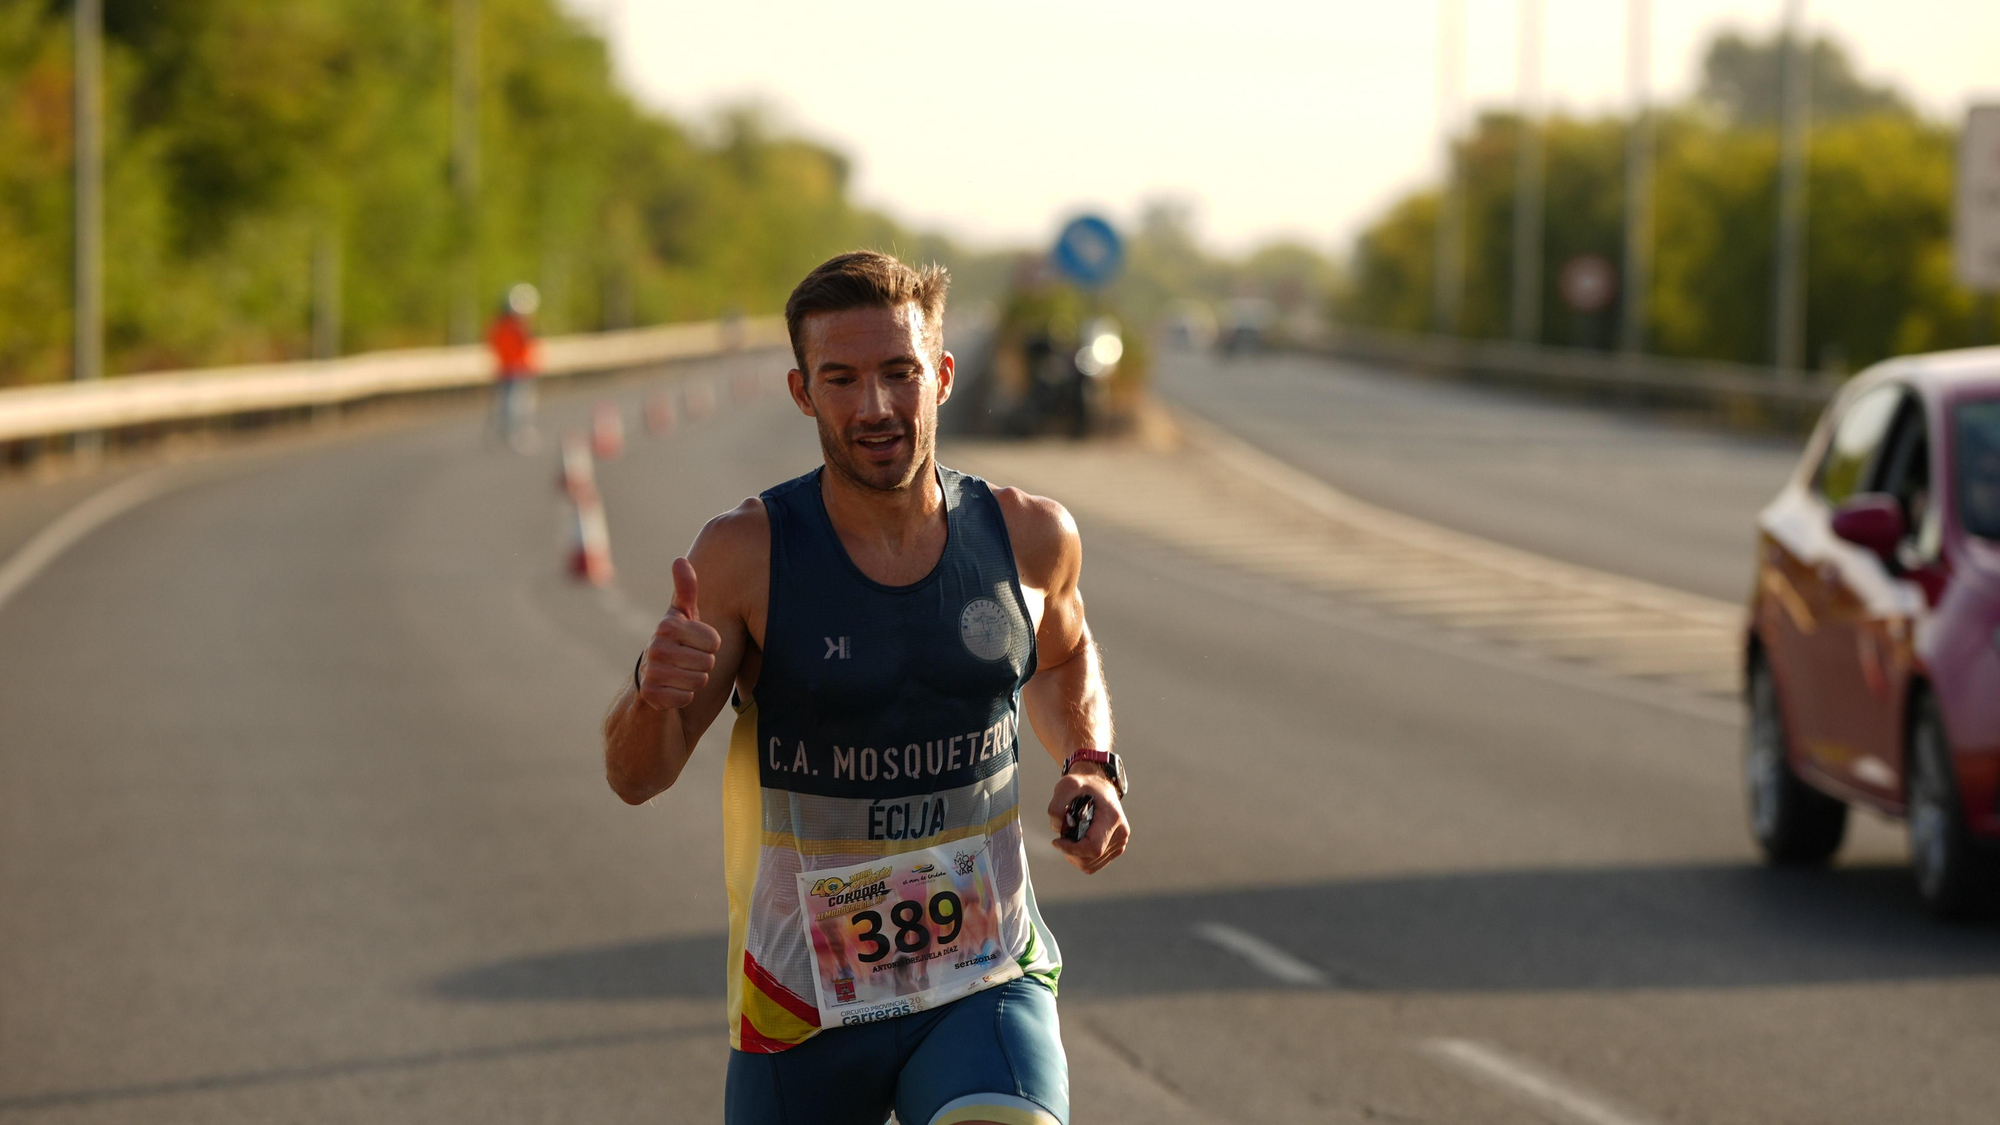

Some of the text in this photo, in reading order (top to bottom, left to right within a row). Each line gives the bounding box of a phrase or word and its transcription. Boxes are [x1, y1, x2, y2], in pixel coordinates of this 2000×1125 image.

[769, 736, 818, 776] C.A.
[868, 797, 945, 841] ÉCIJA
[810, 877, 846, 897] 40
[851, 891, 963, 963] 389
[872, 946, 958, 973] ANTONIO OREJUELA DÍAZ
[954, 953, 997, 970] serizona
[840, 1008, 869, 1017] CIRCUITO
[870, 1000, 908, 1011] PROVINCIAL
[909, 996, 922, 1006] 20
[842, 1005, 911, 1025] carreras
